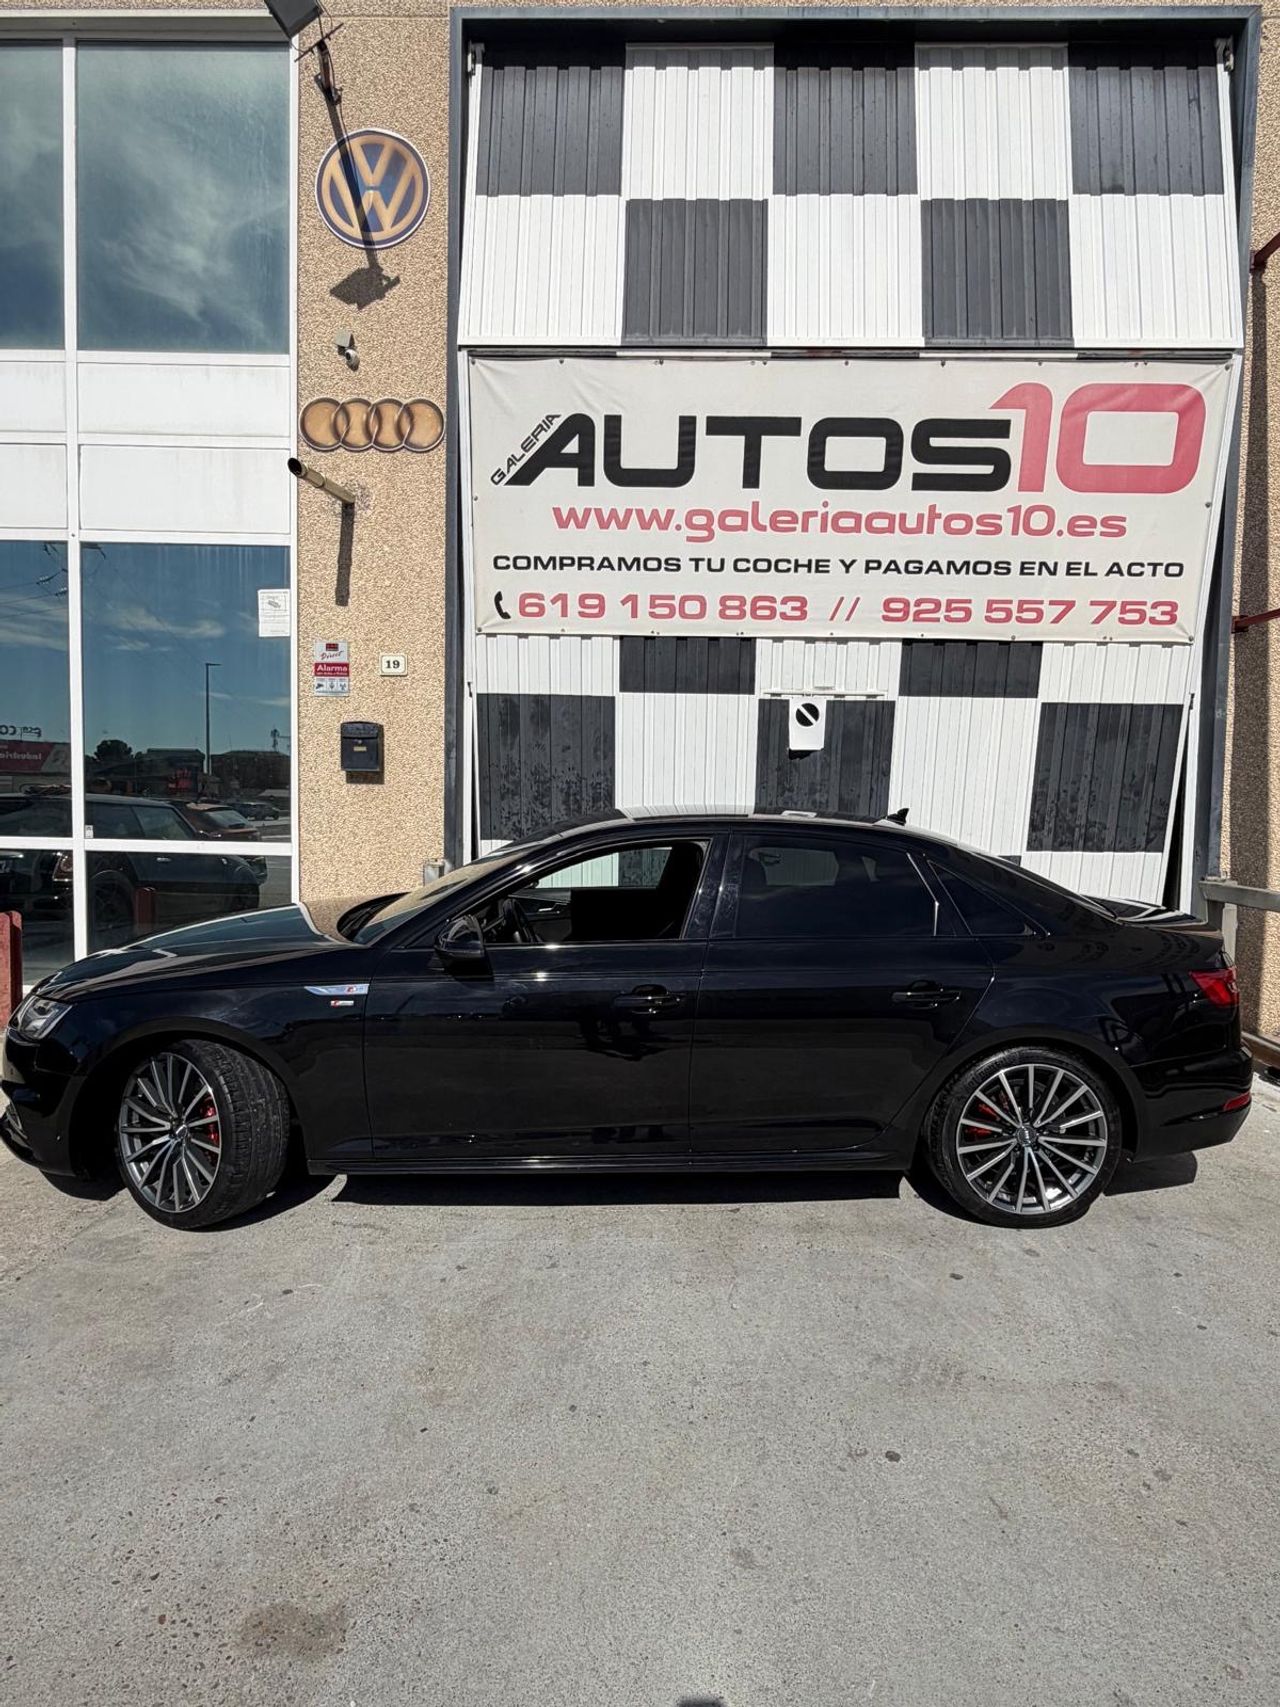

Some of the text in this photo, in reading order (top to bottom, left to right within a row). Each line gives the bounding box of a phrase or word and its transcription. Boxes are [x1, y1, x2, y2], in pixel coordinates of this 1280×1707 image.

[490, 413, 562, 486] GALERIA
[553, 501, 1127, 543] www.galeriaautos10.es
[493, 555, 1184, 578] COMPRAMOS TU COCHE Y PAGAMOS EN EL ACTO
[518, 592, 1179, 625] 619 150 863 // 925 557 753
[317, 664, 347, 672] Alarma
[386, 660, 400, 669] 19
